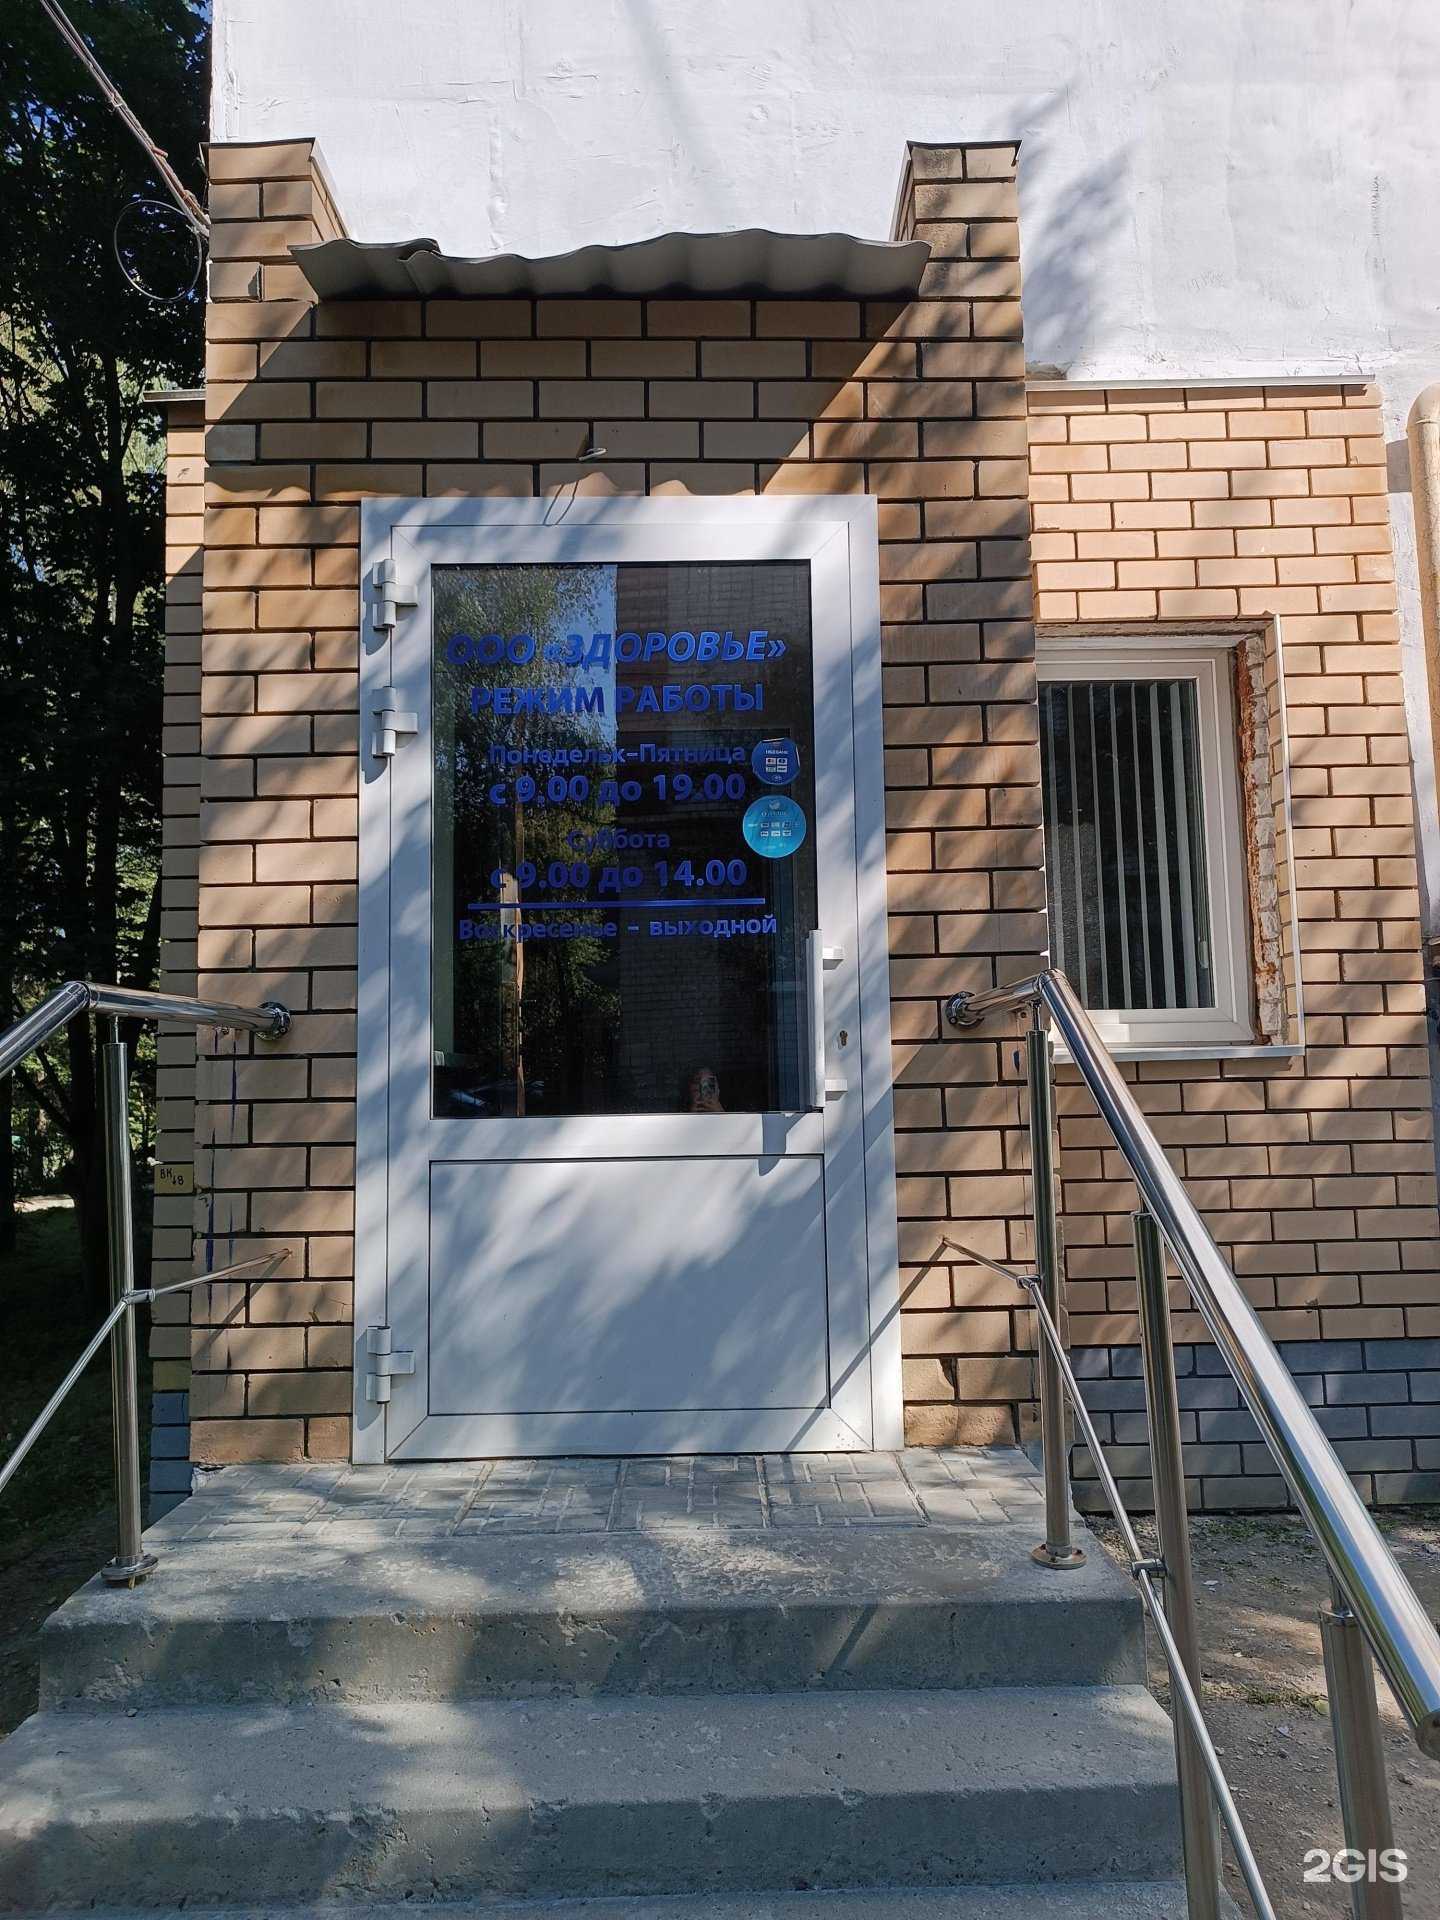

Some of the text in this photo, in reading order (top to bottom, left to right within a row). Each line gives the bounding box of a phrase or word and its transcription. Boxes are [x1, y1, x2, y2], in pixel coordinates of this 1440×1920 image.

[446, 630, 787, 672] ООО «ЗДОРОВЬЕ»
[470, 683, 765, 714] РЕЖИМ РАБОТЫ
[489, 773, 746, 806] с 9.00 до 19.00
[515, 861, 591, 889] 9.00
[598, 866, 645, 893] до
[655, 859, 748, 887] 14.00
[649, 913, 777, 938] выходной
